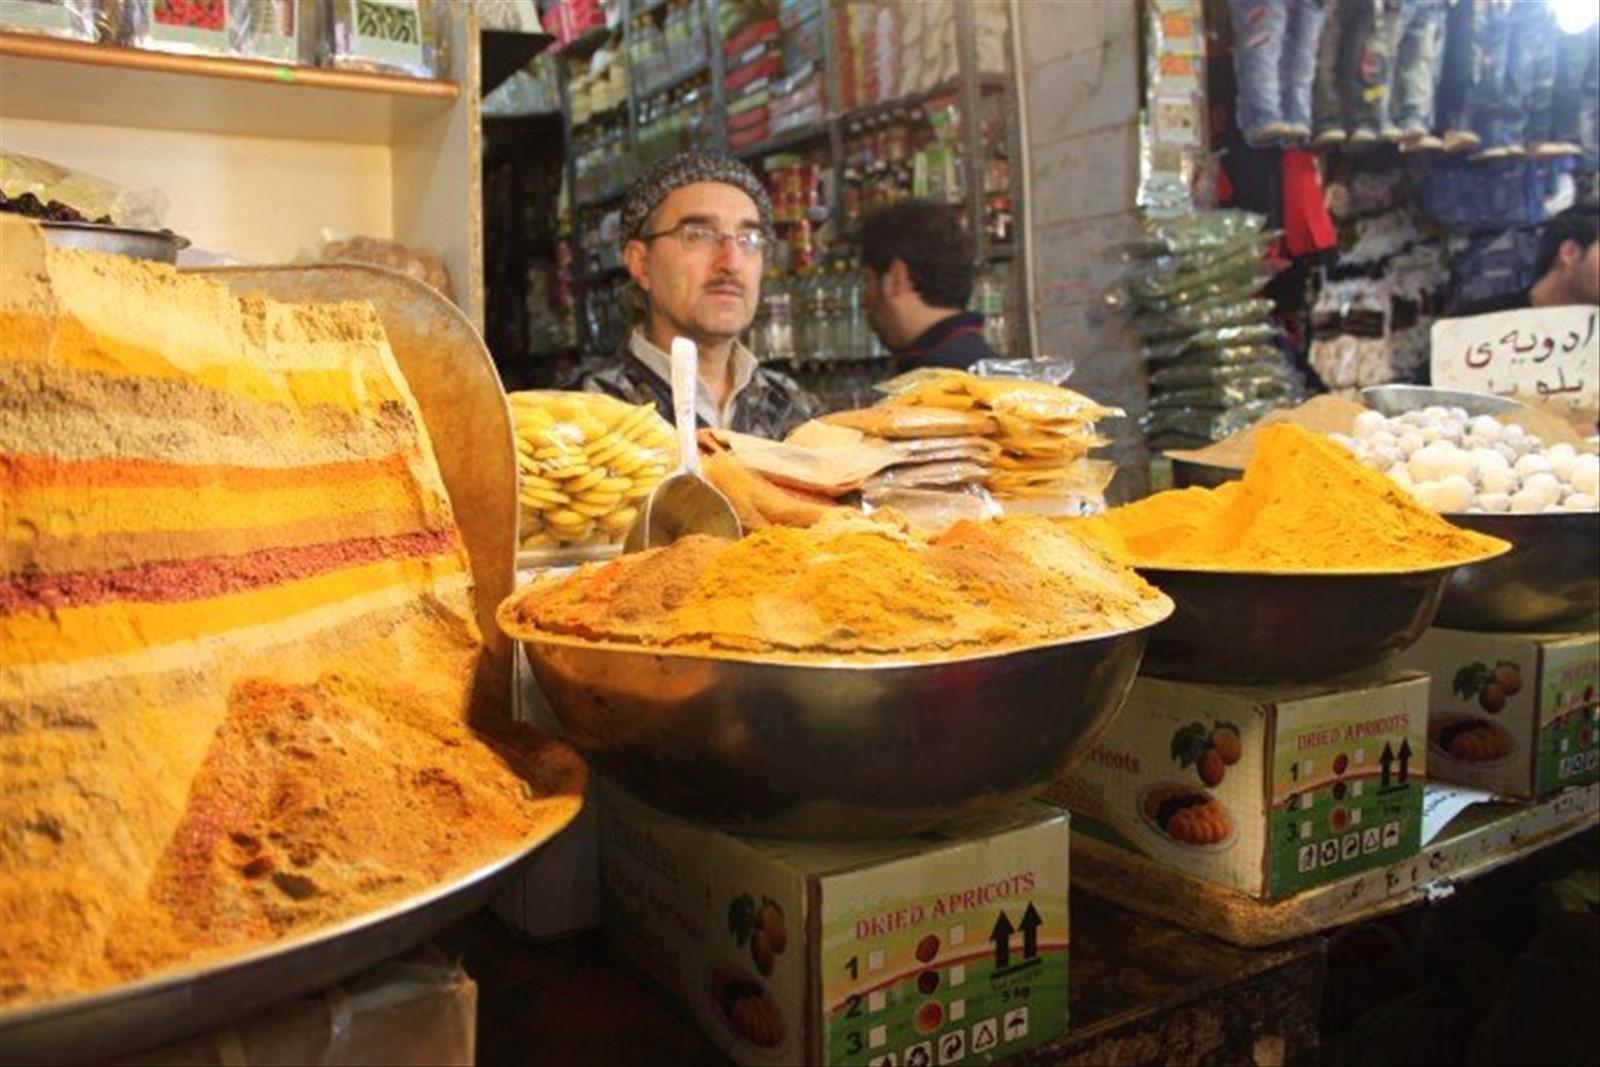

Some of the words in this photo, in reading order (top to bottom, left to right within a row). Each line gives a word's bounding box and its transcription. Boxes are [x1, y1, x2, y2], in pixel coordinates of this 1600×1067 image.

[1298, 727, 1340, 751] DRIED
[1344, 713, 1410, 742] APRICOTS
[1290, 762, 1299, 782] 1
[1287, 792, 1299, 812] 2
[856, 906, 924, 940] DRIED
[932, 872, 1036, 920] APRICOTS
[845, 955, 859, 980] 1
[845, 993, 863, 1019] 2
[845, 1031, 863, 1056] 3
